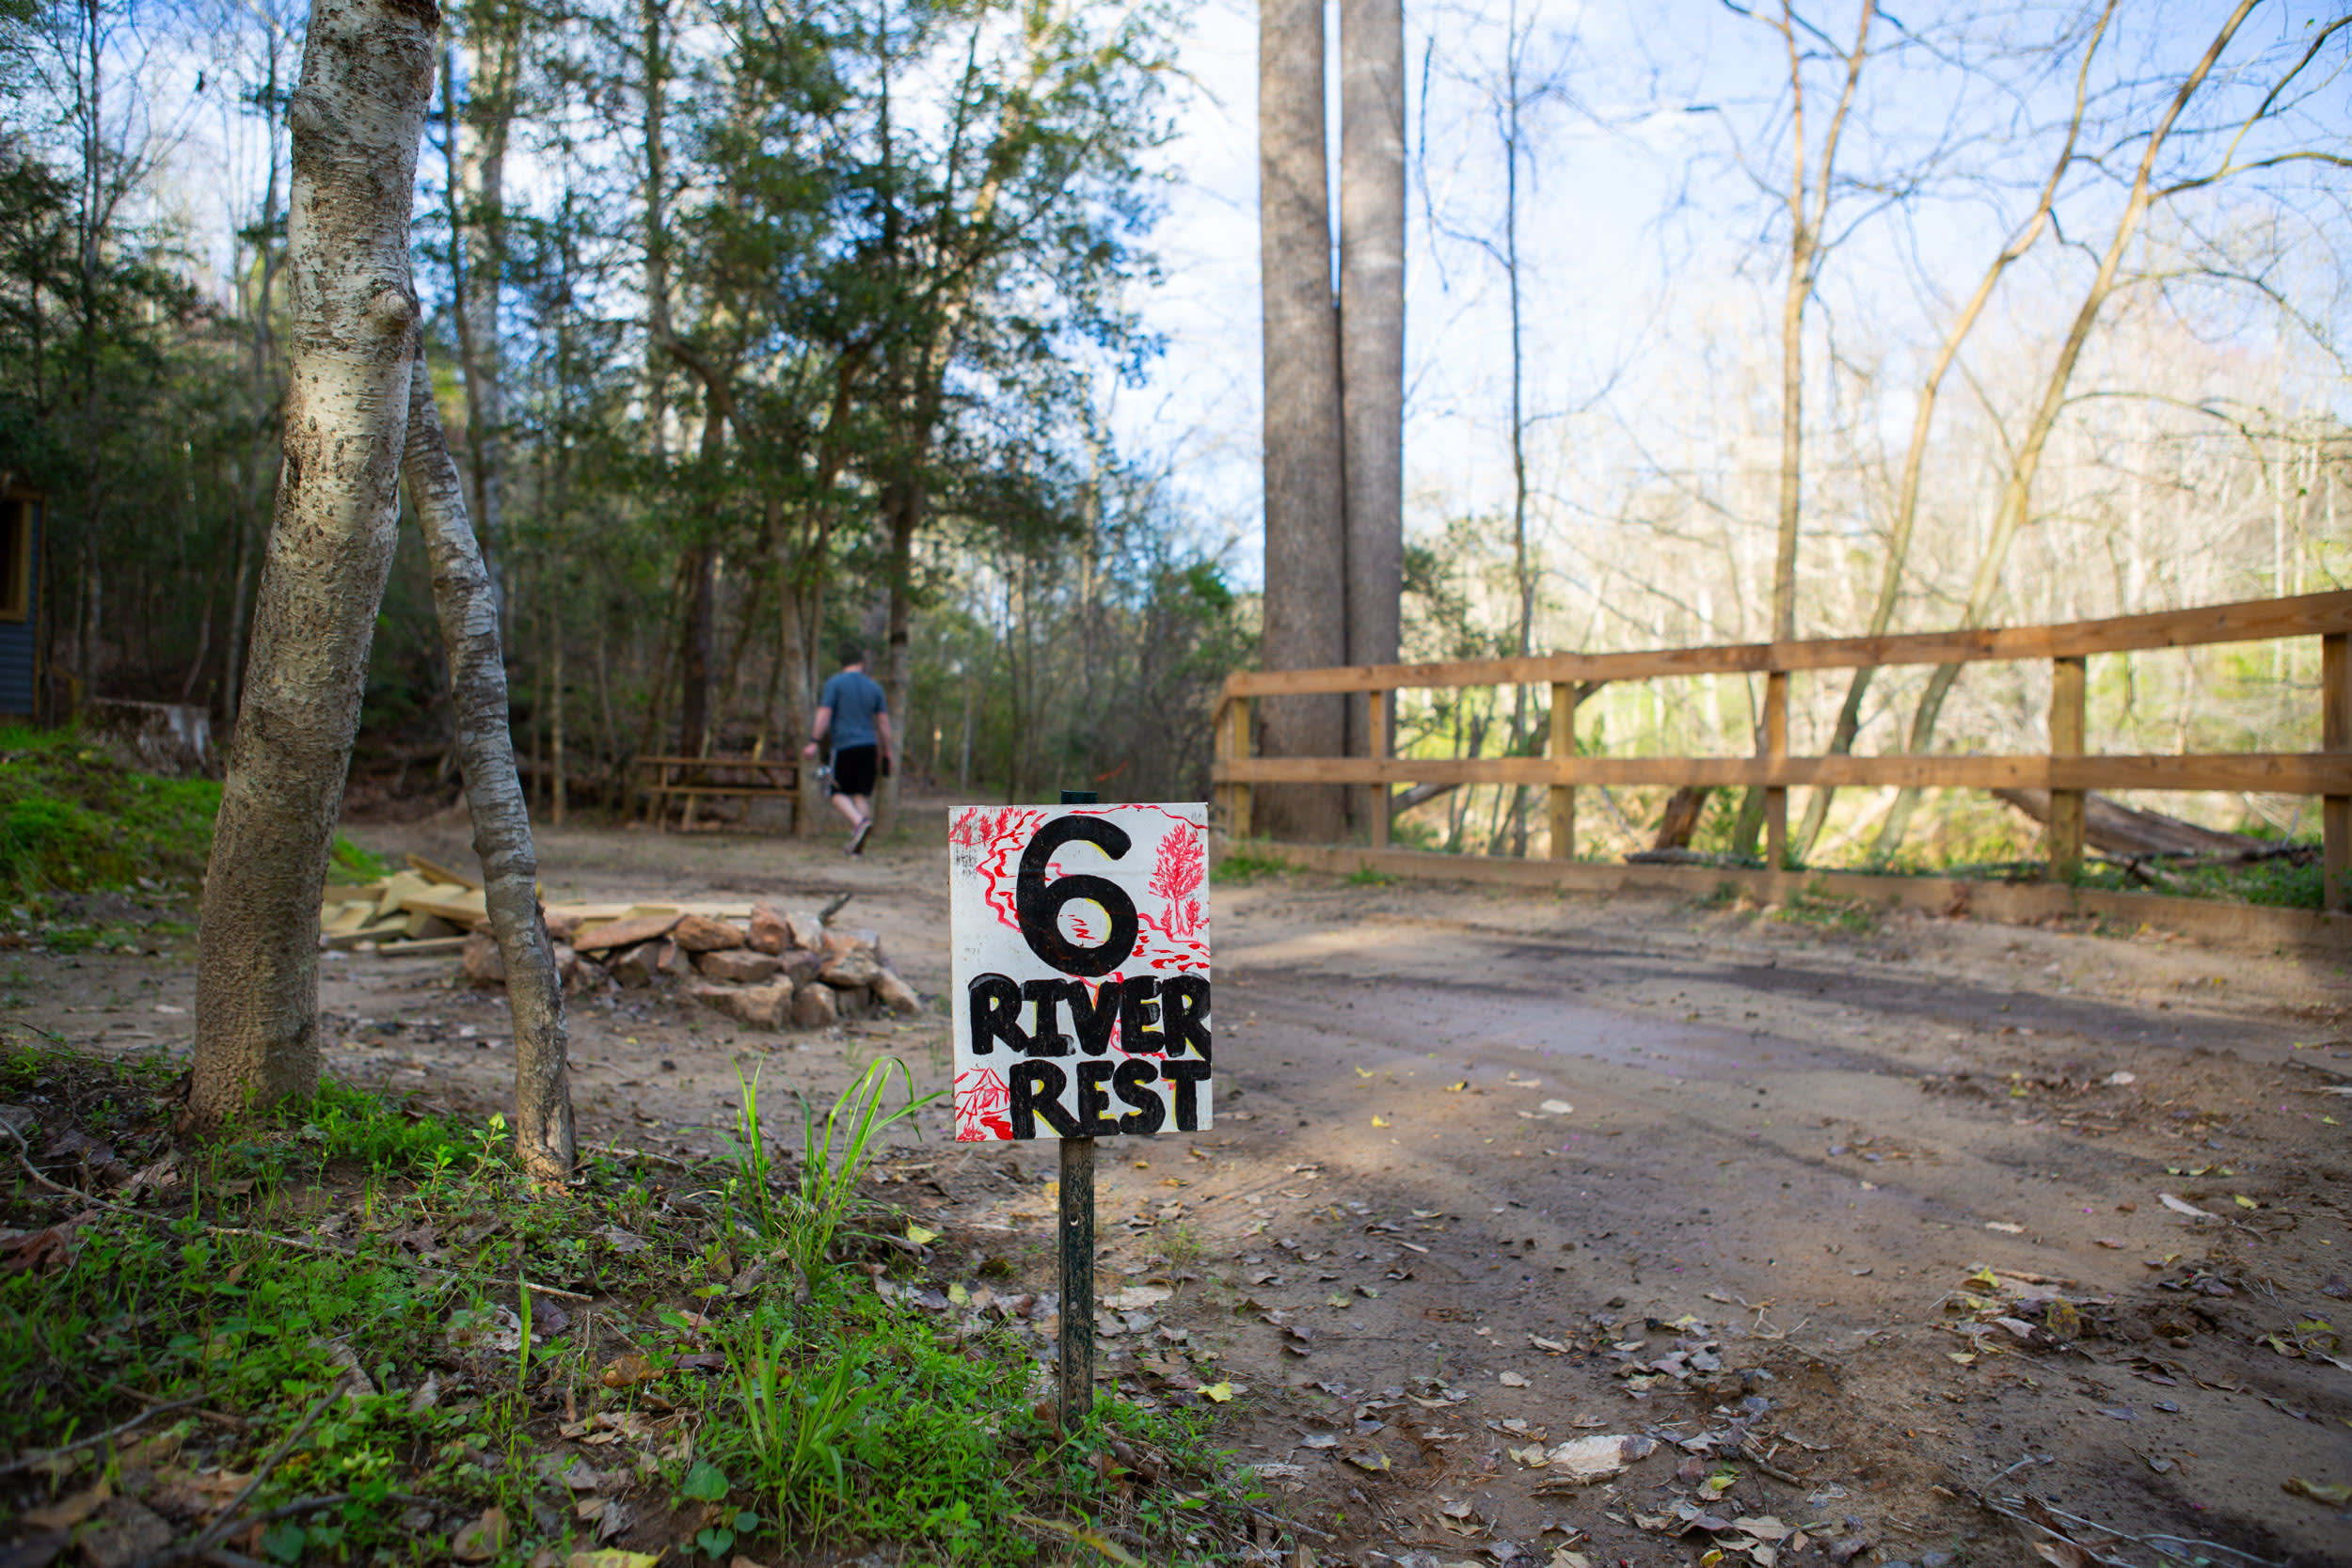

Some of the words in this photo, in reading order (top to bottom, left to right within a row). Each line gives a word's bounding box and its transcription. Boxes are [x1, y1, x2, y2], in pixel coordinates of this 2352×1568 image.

[1016, 815, 1138, 976] 6
[968, 972, 1211, 1062] RIVER
[1009, 1058, 1212, 1139] REST
